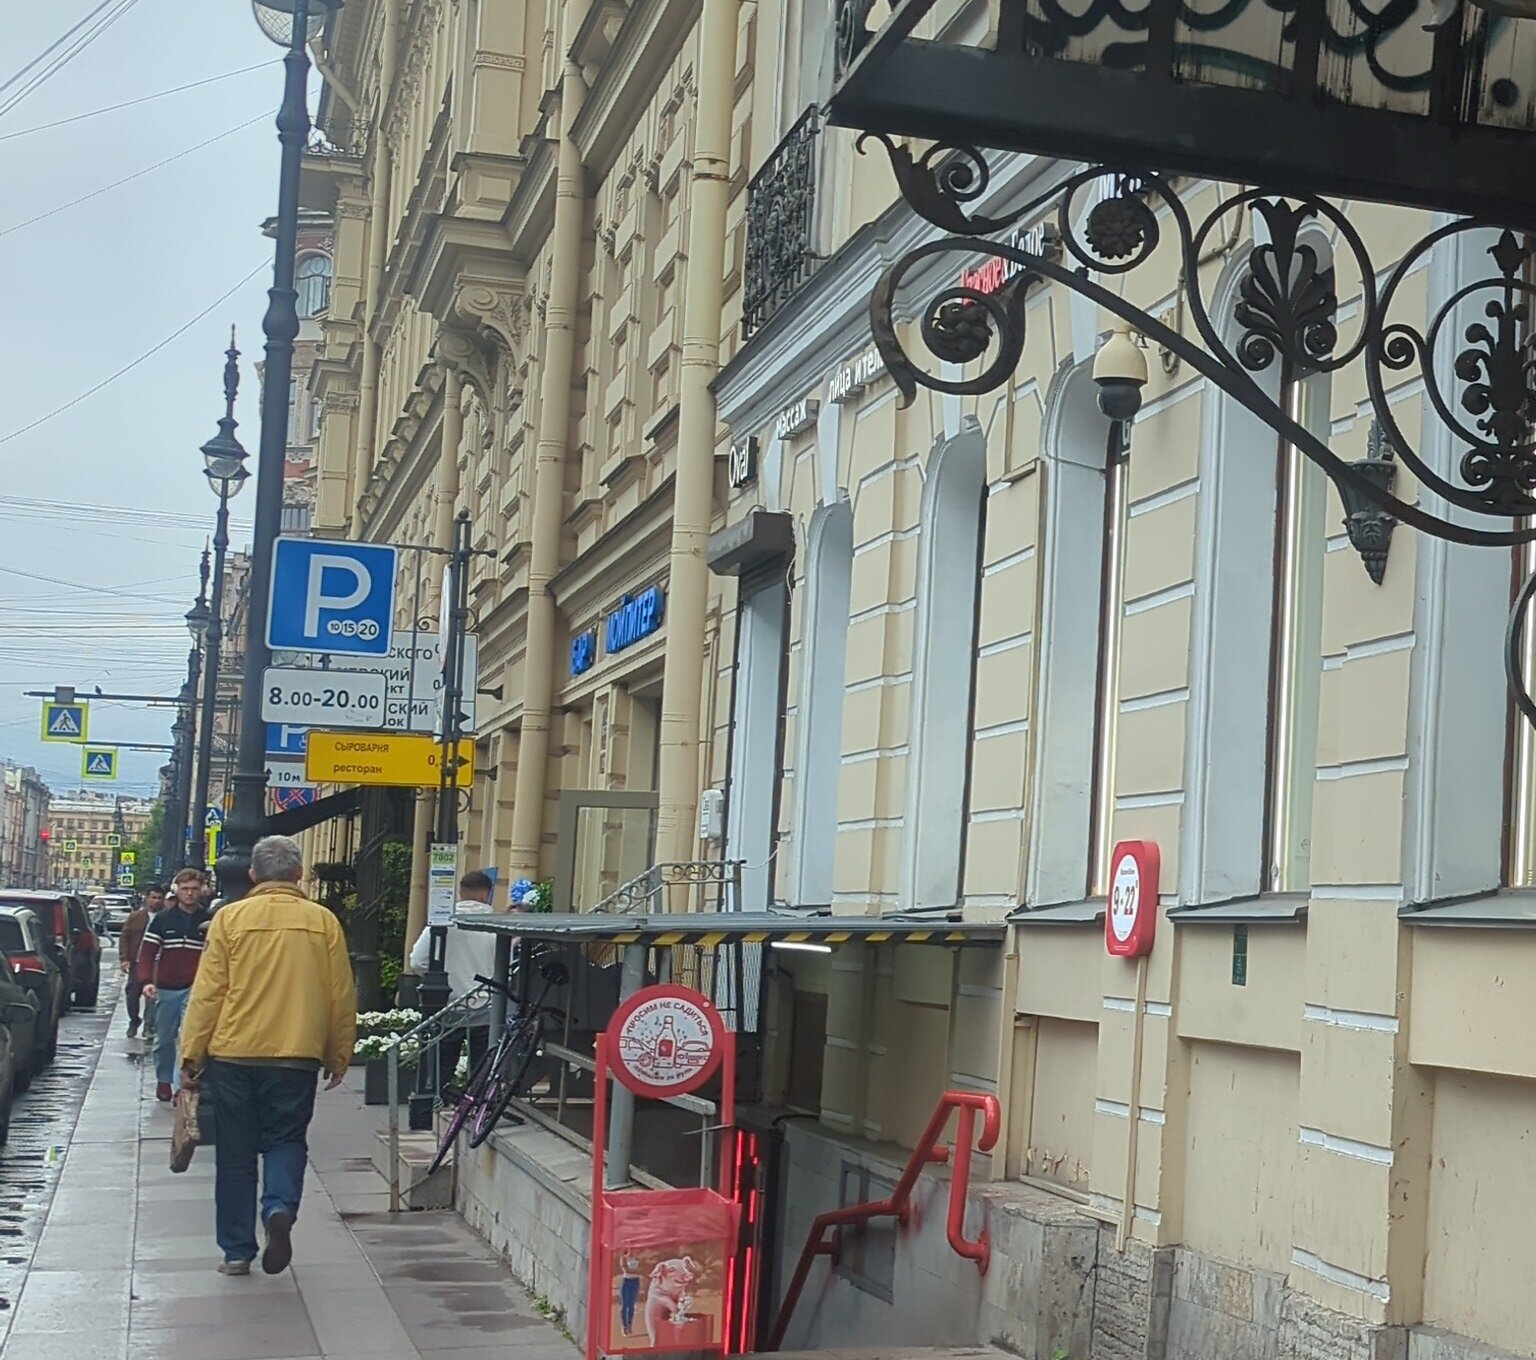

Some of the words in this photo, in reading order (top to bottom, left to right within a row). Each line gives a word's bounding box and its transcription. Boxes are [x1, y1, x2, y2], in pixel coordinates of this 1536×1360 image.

[776, 398, 807, 440] массаж
[728, 436, 750, 488] Oval
[330, 623, 340, 631] 10
[344, 623, 355, 633] 15
[359, 623, 377, 636] 20
[269, 686, 379, 709] 8.00-20.00
[334, 741, 389, 753] СЫРОВАРНЯ
[278, 772, 291, 782] 10
[333, 763, 382, 775] ресторан
[627, 1003, 658, 1035] ПРОСИМ
[673, 1003, 708, 1037] САДИТЬСЯ
